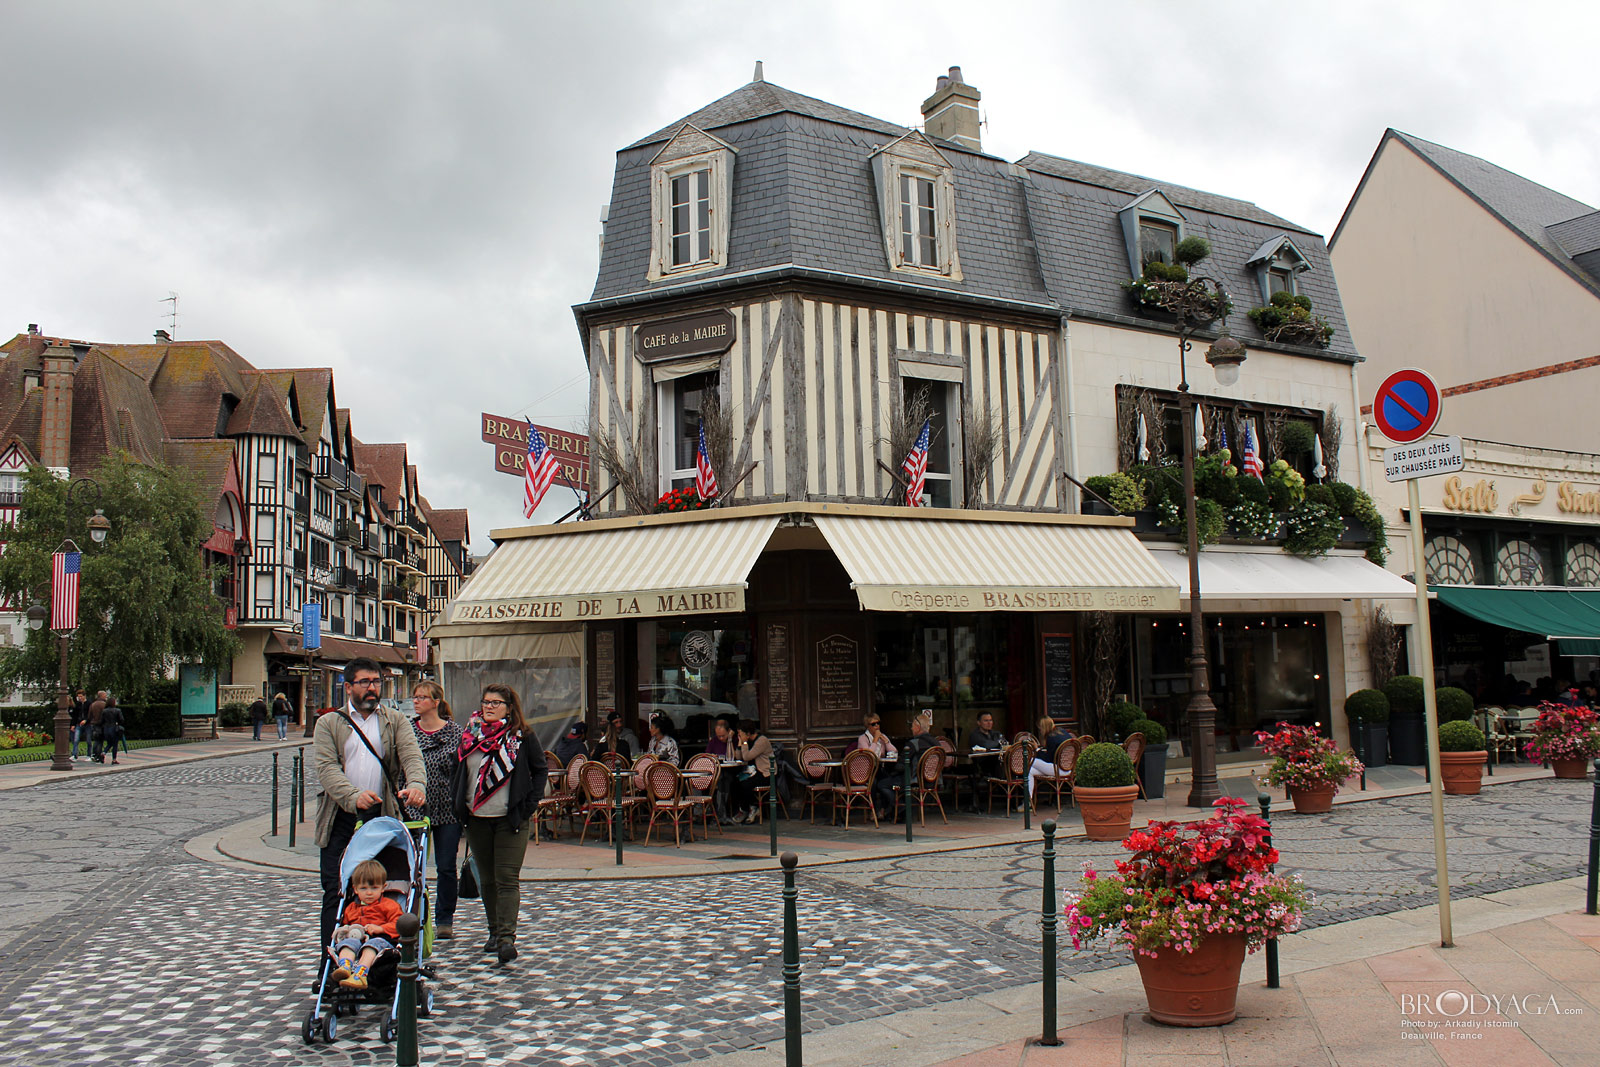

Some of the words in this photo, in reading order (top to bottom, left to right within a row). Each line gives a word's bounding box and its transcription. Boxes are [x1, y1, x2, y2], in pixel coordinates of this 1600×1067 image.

[643, 334, 667, 349] CAFE
[669, 332, 680, 345] de
[682, 331, 690, 342] la
[693, 323, 727, 341] MAIRIE
[1393, 451, 1407, 462] DES
[1408, 447, 1427, 459] DEUX
[1428, 443, 1451, 455] CÔTÉS
[1385, 466, 1400, 476] SUR
[1401, 458, 1437, 474] CHAUSSÉE
[1438, 454, 1462, 468] PAVÉE
[457, 601, 563, 619] BRASSERIE
[576, 599, 602, 617] DE
[616, 597, 641, 615] LA
[656, 591, 737, 613] MAIRIE
[891, 590, 970, 610] Crêperie
[982, 591, 1094, 608] BRASSERIE
[1104, 591, 1156, 607] Glacier
